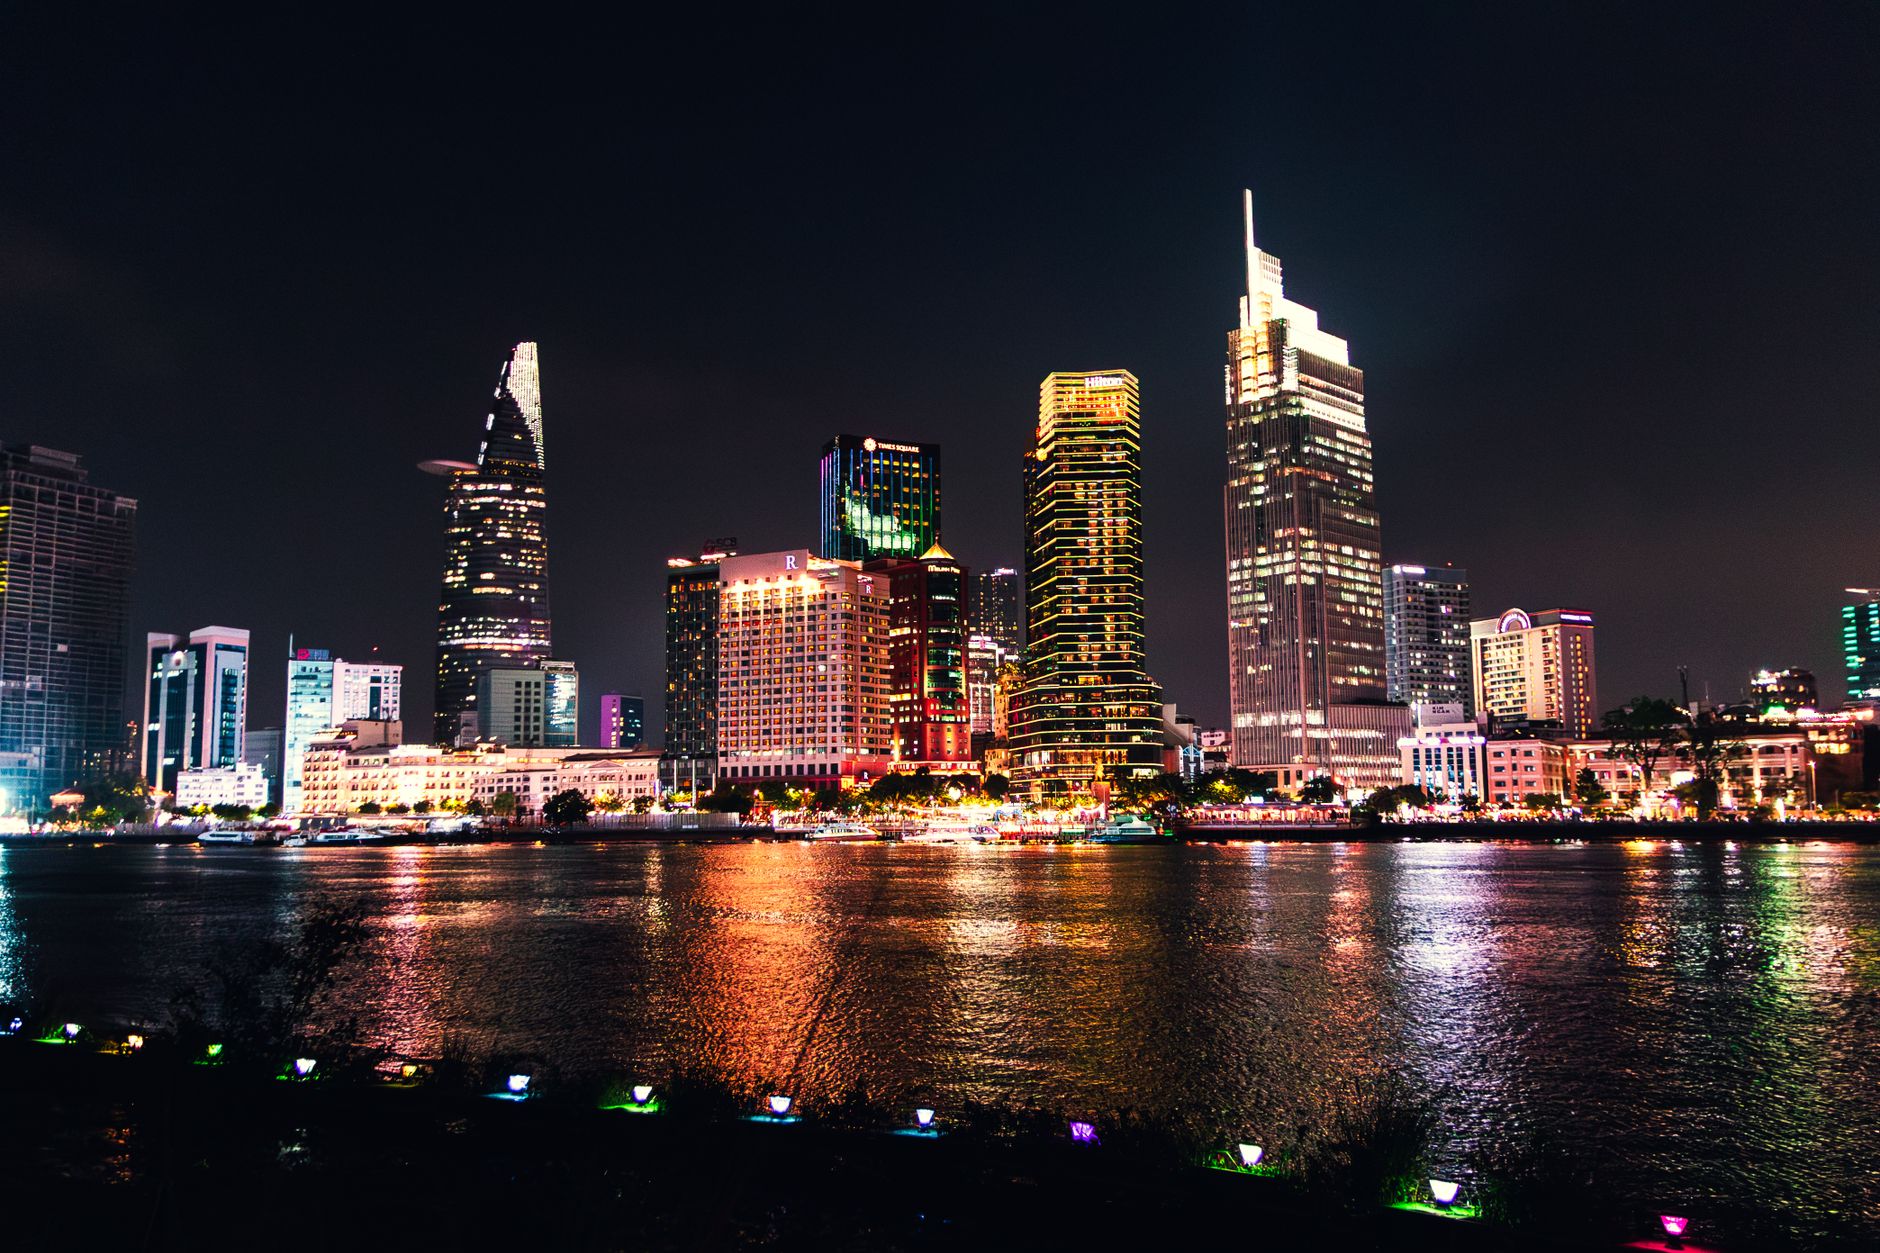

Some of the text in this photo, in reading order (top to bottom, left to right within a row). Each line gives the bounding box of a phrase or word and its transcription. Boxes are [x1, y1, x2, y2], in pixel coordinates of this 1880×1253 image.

[878, 442, 920, 453] TIMES SQUARE
[785, 555, 798, 570] R
[866, 584, 871, 594] R
